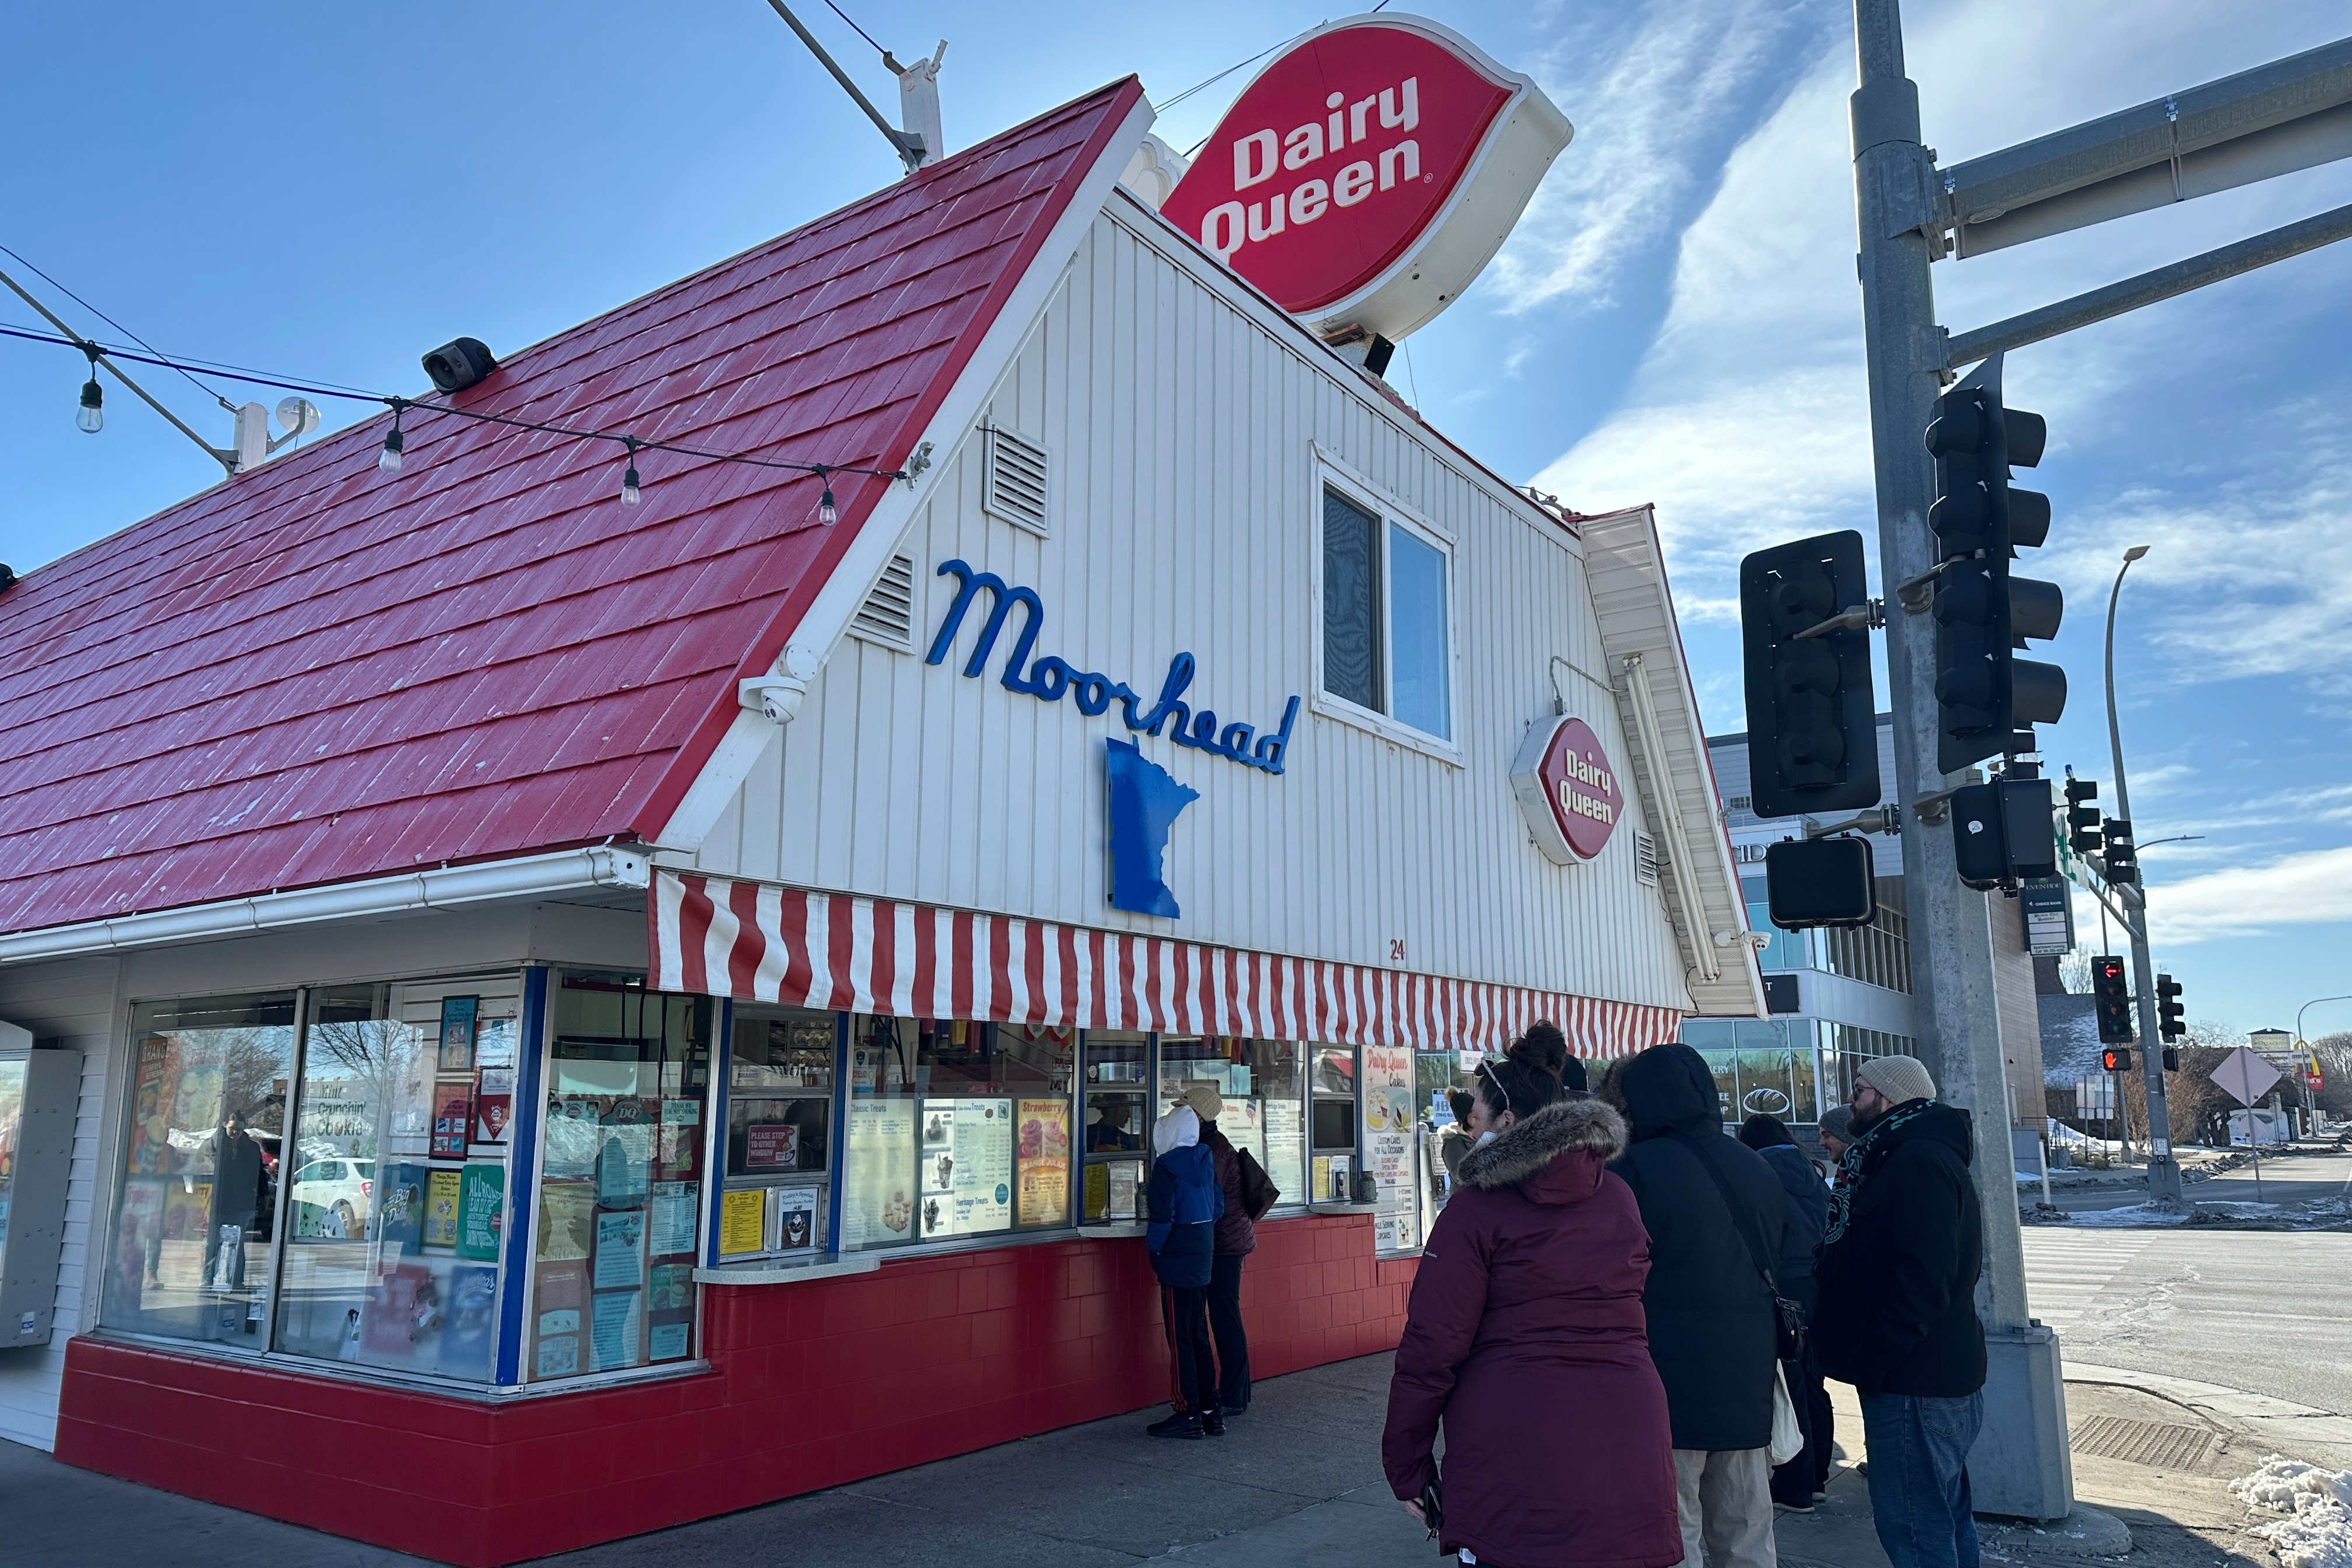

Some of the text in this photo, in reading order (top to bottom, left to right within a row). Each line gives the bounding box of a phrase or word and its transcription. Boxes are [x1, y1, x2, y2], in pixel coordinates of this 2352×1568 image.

[1234, 76, 1420, 191] Dairy
[1201, 139, 1420, 266] Queen
[925, 559, 1301, 775] Moorhead
[1565, 748, 1611, 797] Dairy
[1559, 779, 1613, 825] Queen
[1390, 939, 1405, 960] 24
[1367, 1048, 1408, 1075] Dairy Queen
[1709, 1065, 1730, 1074] KERY
[1389, 1072, 1406, 1088] Cakes
[318, 1101, 367, 1116] Crunchin'
[618, 1107, 637, 1119] DQ
[870, 1103, 887, 1112] Treats
[971, 1102, 985, 1111] Treats
[1023, 1101, 1062, 1115] Strawberry
[1226, 1104, 1239, 1112] Menu
[316, 1118, 363, 1136] Cookie
[751, 1132, 786, 1140] PLEASE STEP
[1390, 1135, 1401, 1144] CAKES
[1019, 1158, 1067, 1172] ORANGE JULIUS
[469, 1172, 481, 1198] ALL
[394, 1188, 410, 1206] Big
[782, 1192, 799, 1200] Today's
[956, 1197, 989, 1207] Heritage Treats
[387, 1207, 411, 1227] Dilly
[467, 1212, 489, 1221] HISTORIC
[1382, 1220, 1395, 1228] SERVING
[1376, 1231, 1391, 1240] CUPCAKES
